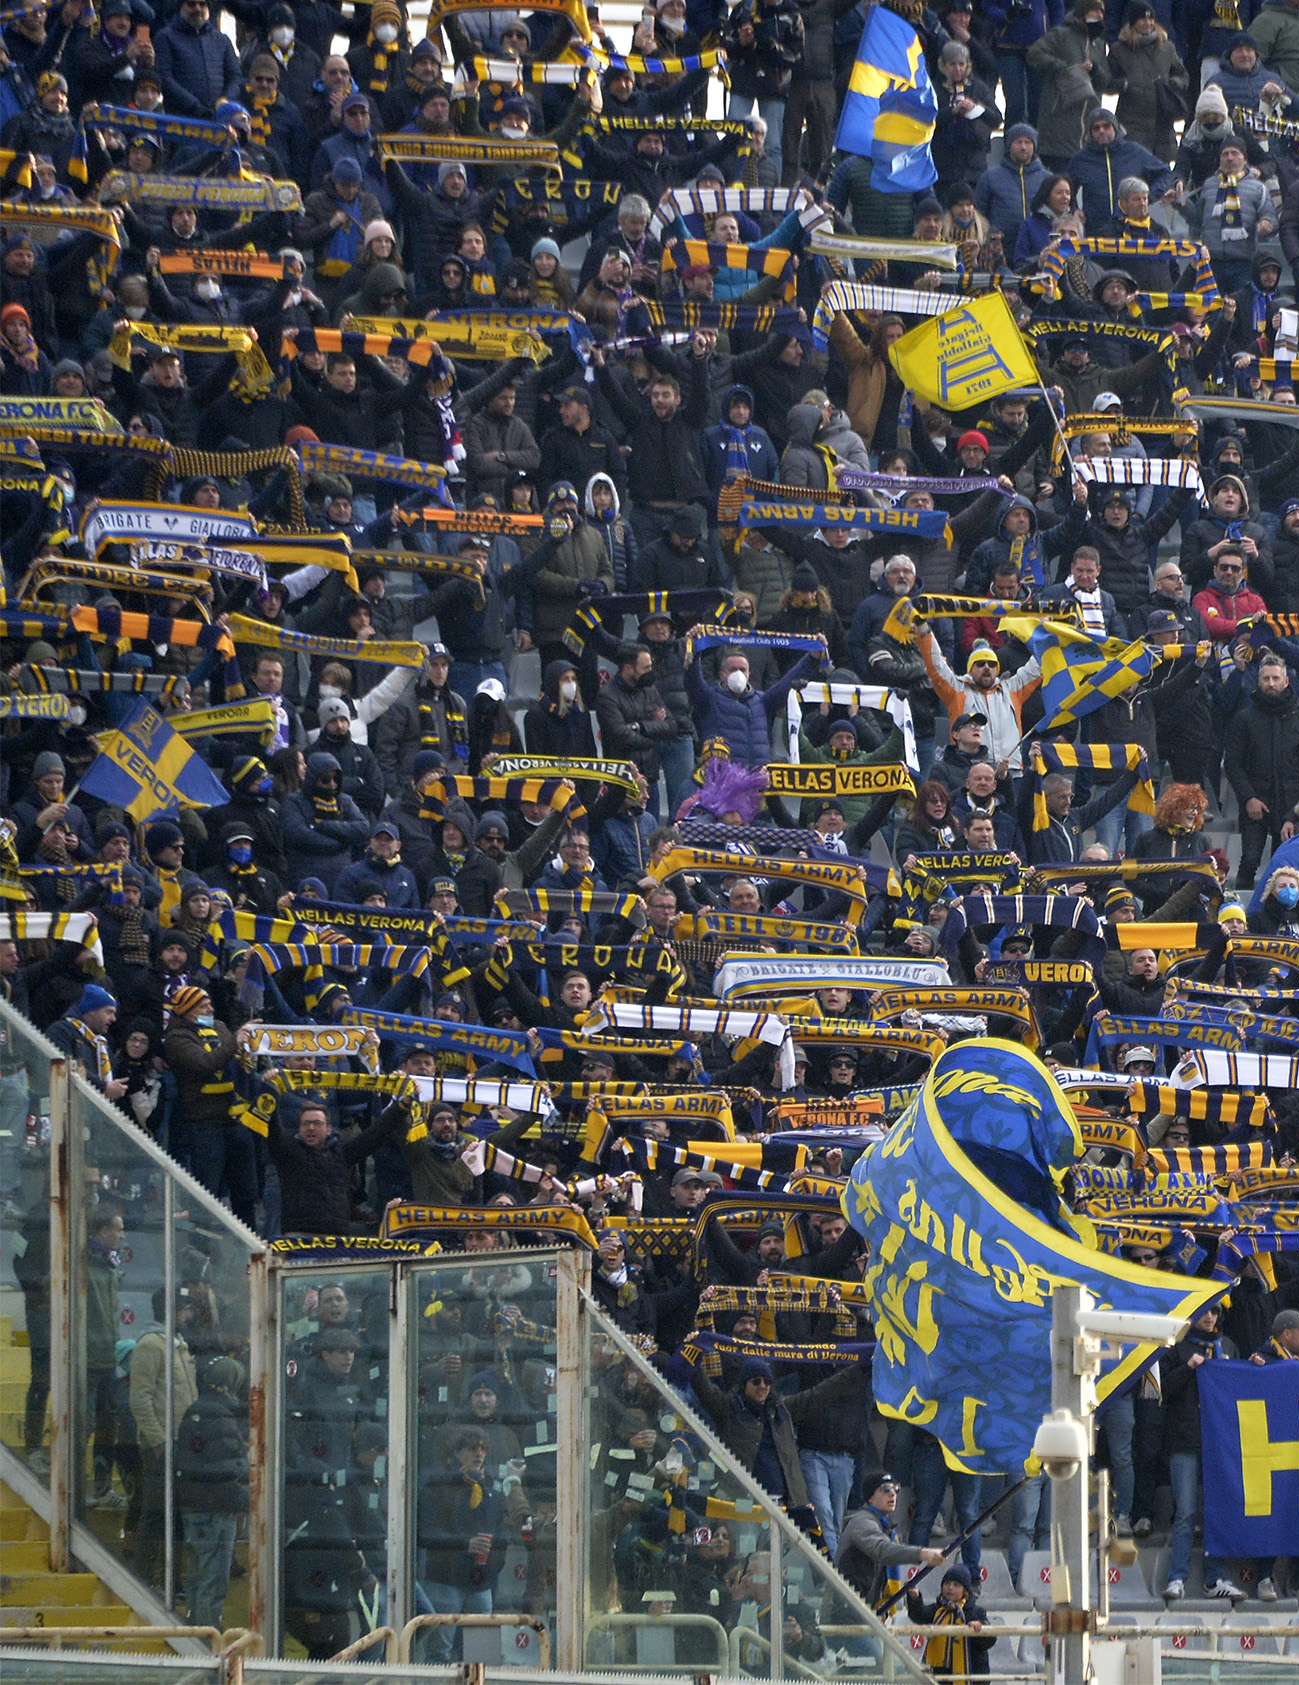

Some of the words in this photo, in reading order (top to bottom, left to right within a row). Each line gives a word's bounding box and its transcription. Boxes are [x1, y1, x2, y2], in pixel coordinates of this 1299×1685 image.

[613, 114, 676, 131] HELLAS
[679, 118, 745, 135] VERONA
[1069, 237, 1198, 259] HELLAS
[446, 312, 570, 330] VERONA
[1028, 320, 1090, 338] HELLAS
[1093, 321, 1160, 345] VERONA
[0, 402, 65, 419] ERONA
[301, 443, 448, 477] HELLAS
[747, 503, 814, 524] ARMY
[824, 505, 919, 528] HELLAS
[771, 767, 832, 790] ELLAS
[840, 765, 913, 789] VERONA
[693, 849, 782, 869] HELLAS
[791, 861, 858, 886] ARMY
[975, 853, 1012, 869] VERO
[296, 909, 355, 929] HELLAS
[360, 913, 426, 932] VERONA
[874, 990, 958, 1013] HELLAS
[967, 990, 1028, 1011] ARMY
[341, 1010, 442, 1039] HELLAS
[451, 1028, 527, 1058] ARMY
[570, 1030, 675, 1051] VERONA
[790, 1026, 861, 1040] ELLAS
[871, 1029, 938, 1048] ARMY
[1098, 1018, 1179, 1037] ELLAS
[1187, 1025, 1242, 1052] ARM
[1054, 1071, 1117, 1085] ELLAS
[601, 1097, 667, 1113] ELLAS
[673, 1097, 727, 1115] ARMY
[1081, 1123, 1128, 1143] RMY
[1093, 1196, 1208, 1213] VERONA
[397, 1209, 487, 1225] HELLAS
[498, 1209, 566, 1225] ARMY
[342, 1237, 421, 1254] VERONA
[741, 1345, 770, 1358] dalle
[821, 1351, 860, 1362] Verona
